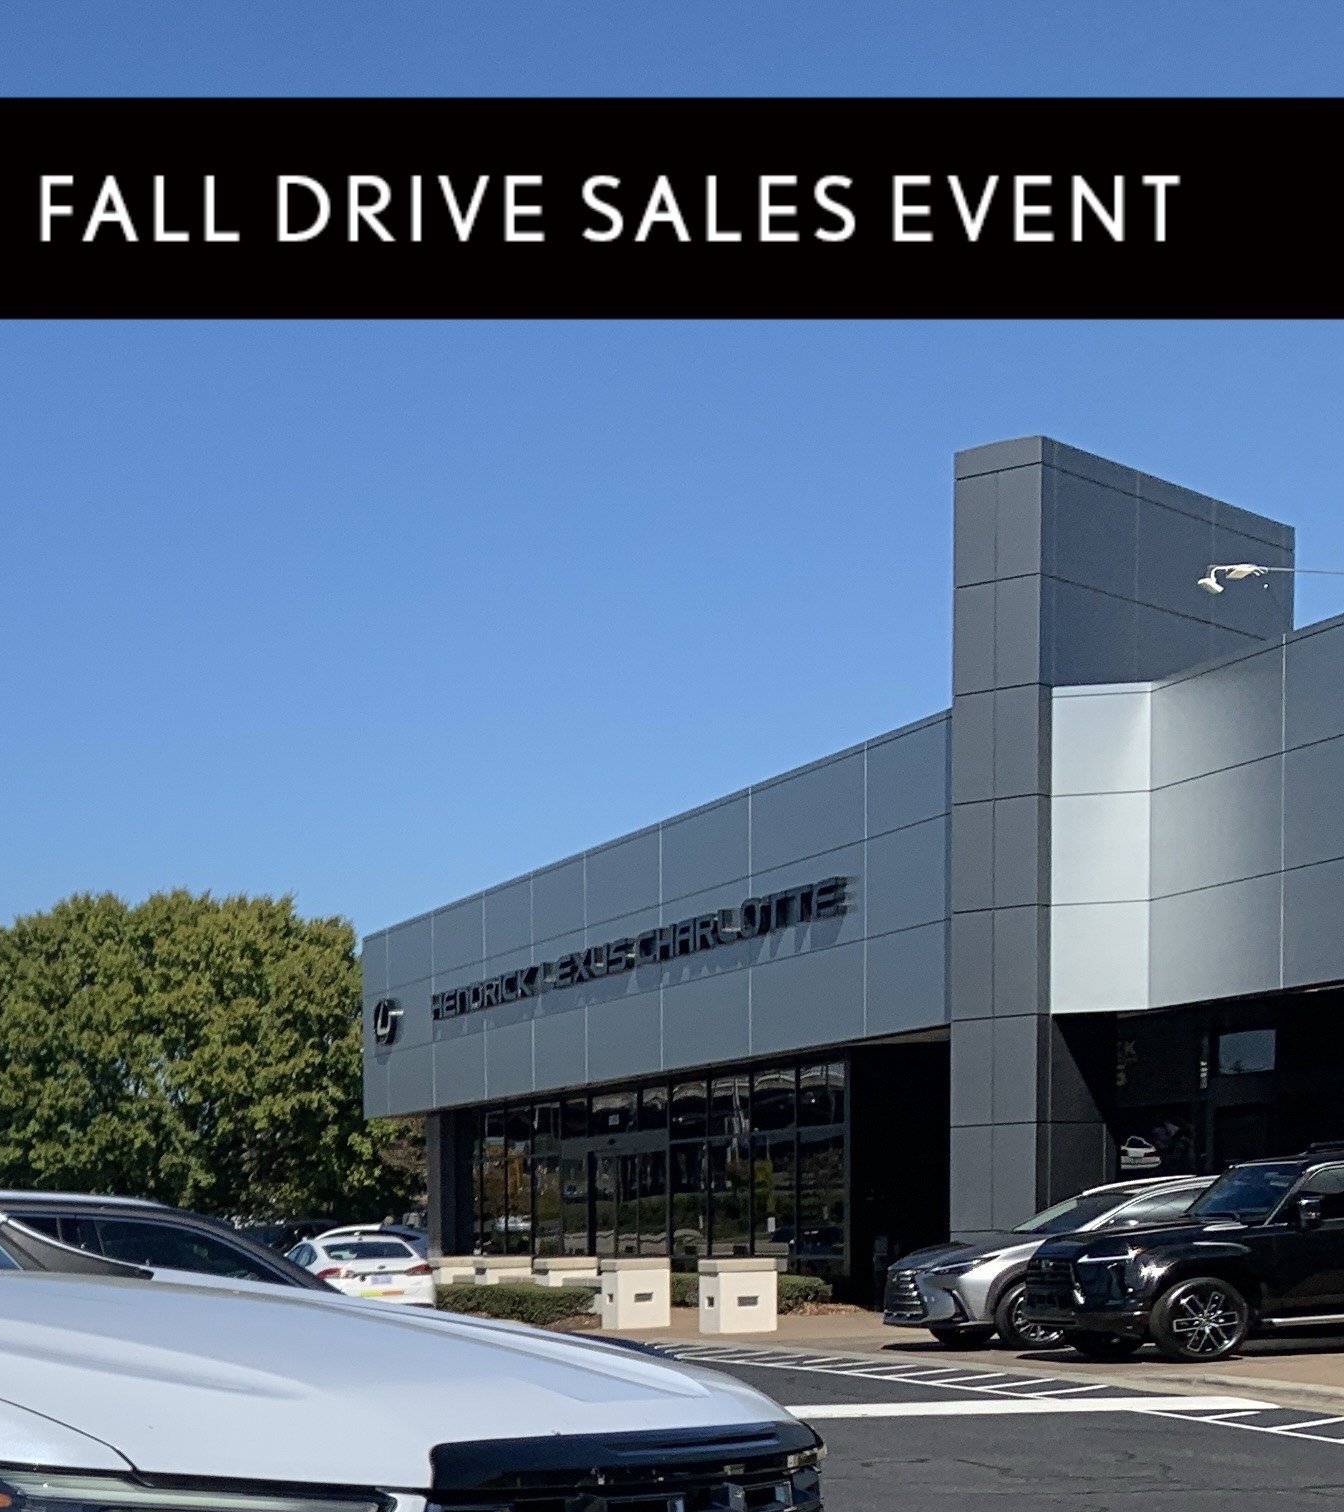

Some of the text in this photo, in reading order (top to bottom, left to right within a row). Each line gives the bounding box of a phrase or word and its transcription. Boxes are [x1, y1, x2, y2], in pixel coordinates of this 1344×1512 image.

[431, 876, 853, 1021] HENDRICK LEXUS CHARLOTTE
